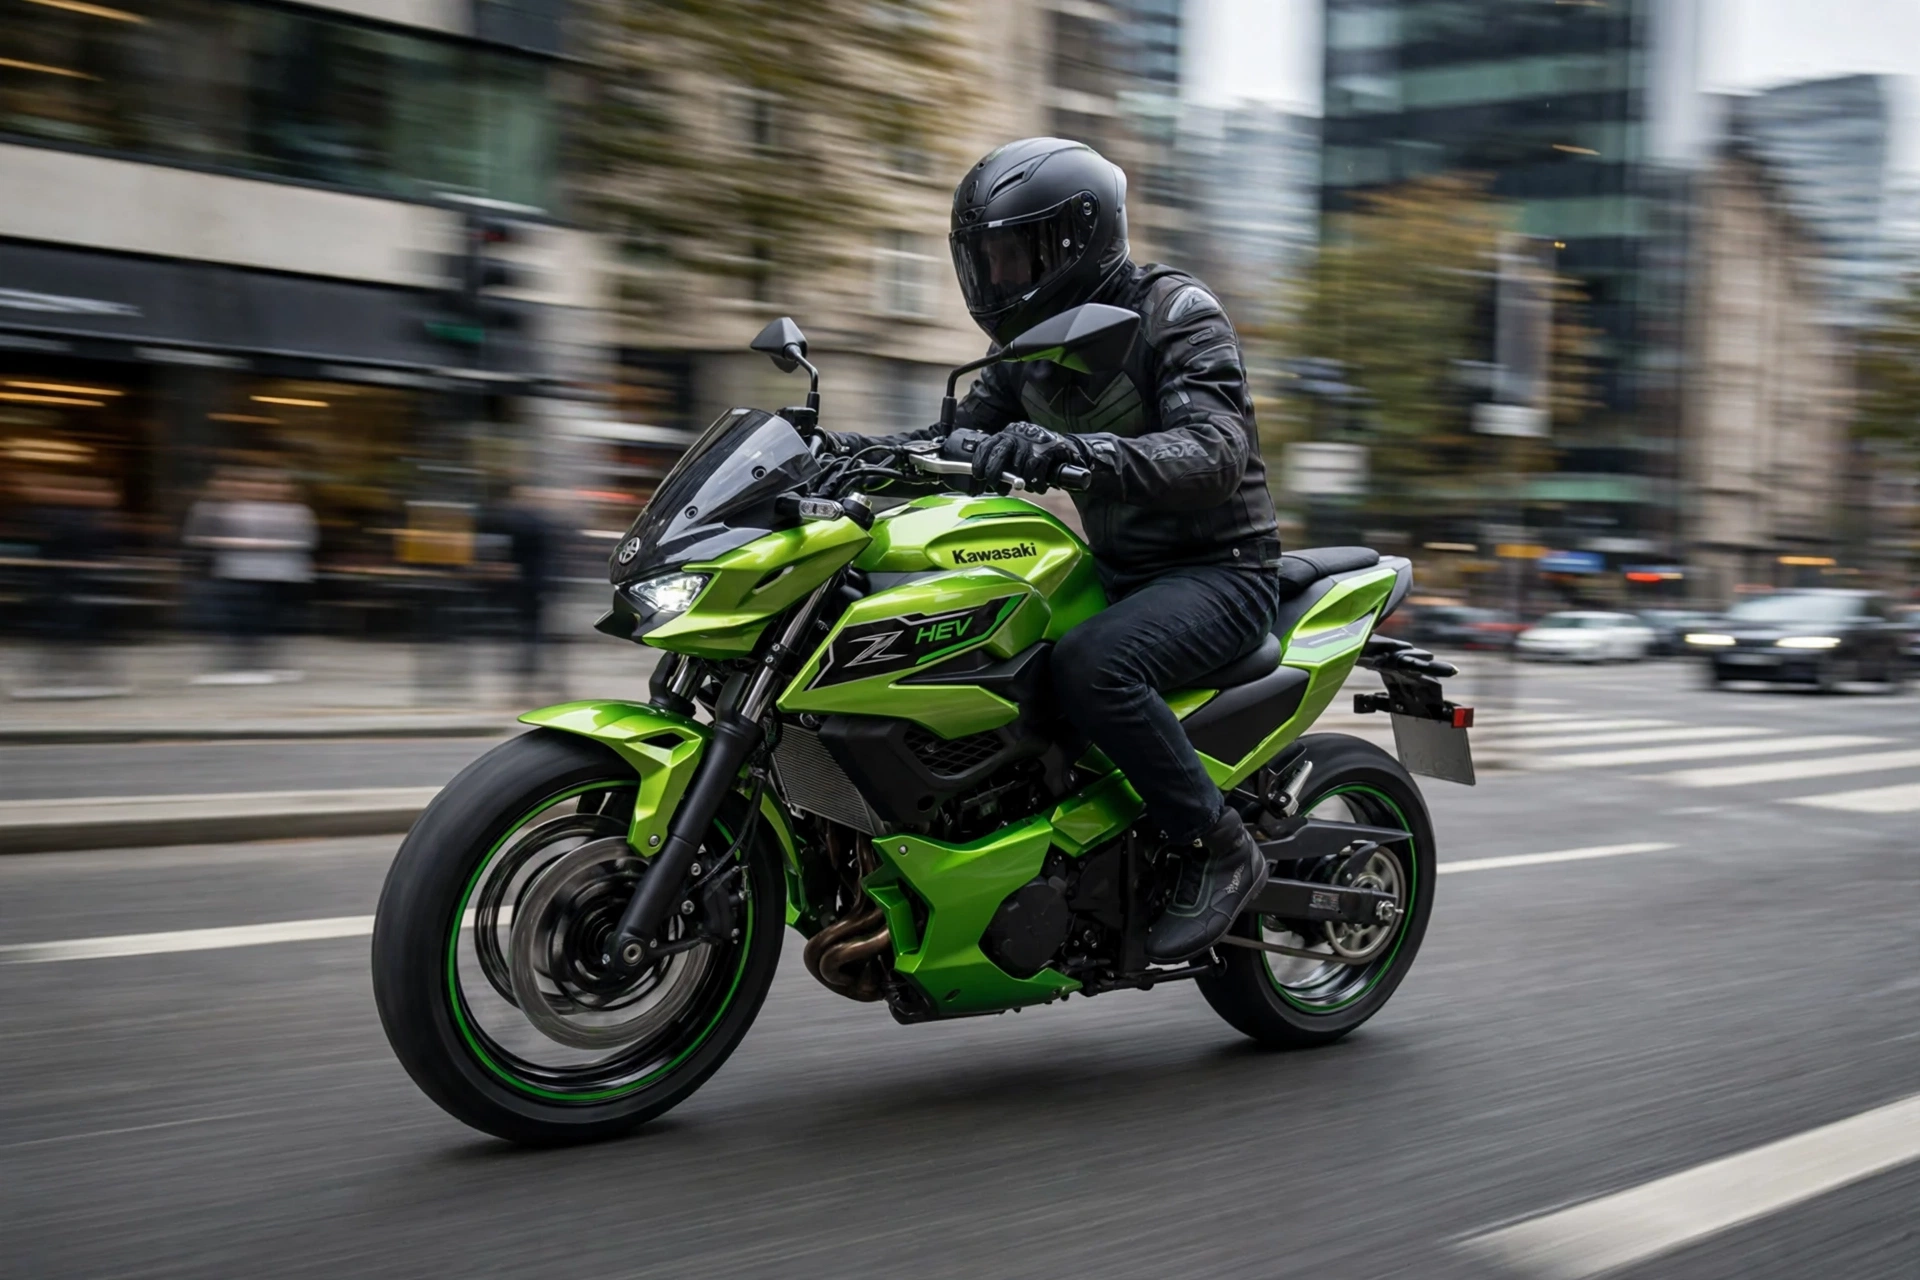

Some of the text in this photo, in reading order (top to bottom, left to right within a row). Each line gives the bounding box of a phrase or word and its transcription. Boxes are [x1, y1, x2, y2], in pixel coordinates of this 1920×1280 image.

[953, 542, 1037, 564] Kawasaki
[843, 617, 973, 668] Z HEV
